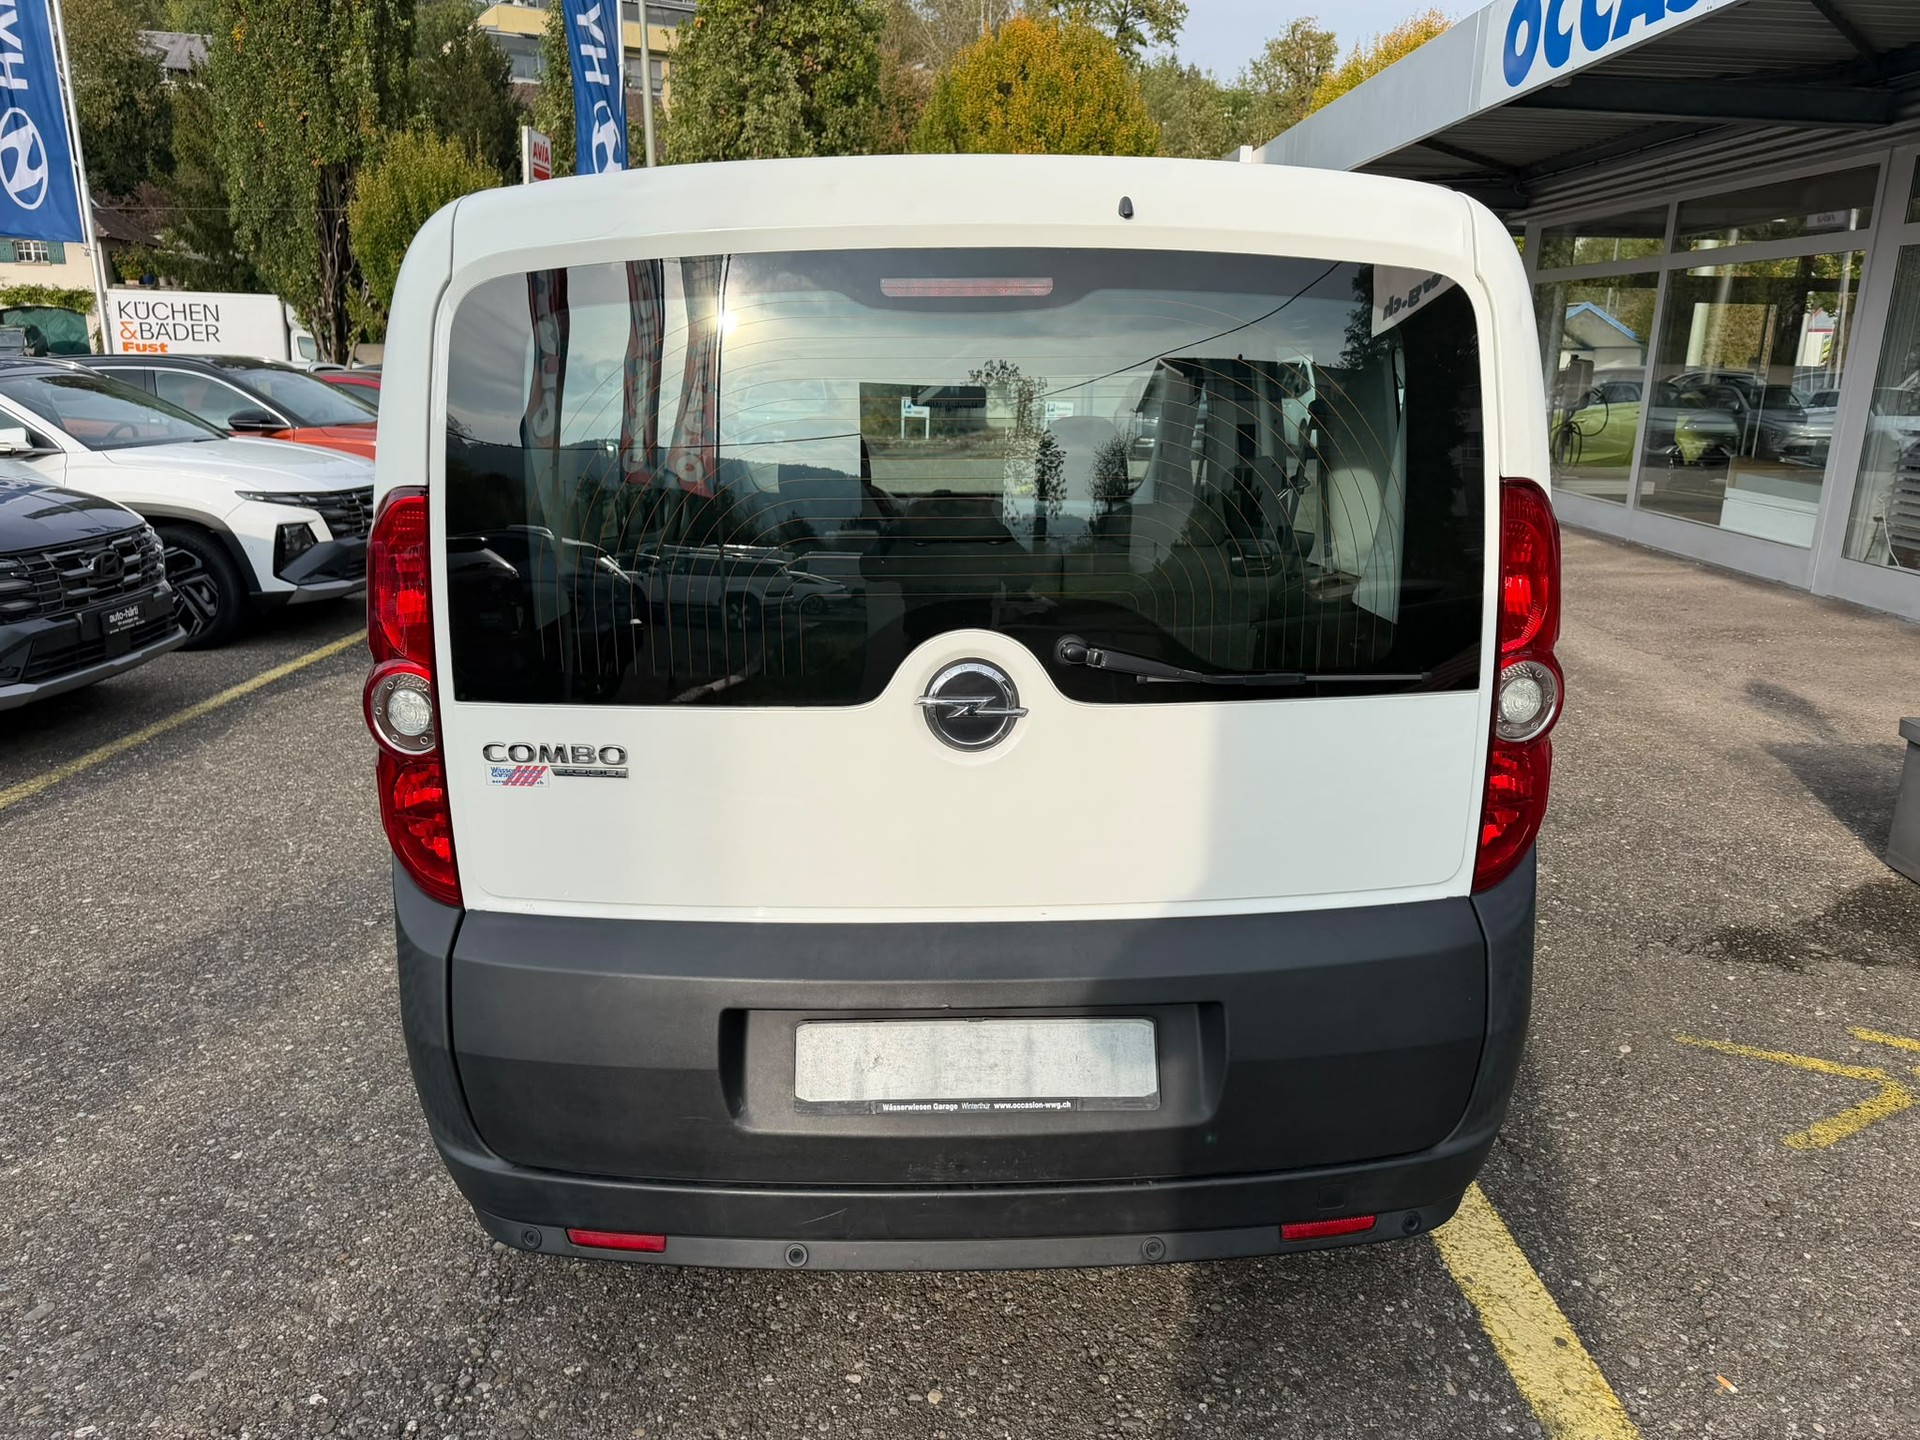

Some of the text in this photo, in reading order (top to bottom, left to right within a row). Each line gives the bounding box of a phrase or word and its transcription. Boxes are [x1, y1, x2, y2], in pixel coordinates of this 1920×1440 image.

[1503, 0, 1702, 87] OCC
[118, 301, 220, 323] KÜCHEN
[122, 341, 168, 353] Fust
[482, 741, 628, 766] COMBO
[882, 1101, 1072, 1112] Wässerwiesen Garage Winterthur www.occasion-wwg.ch
